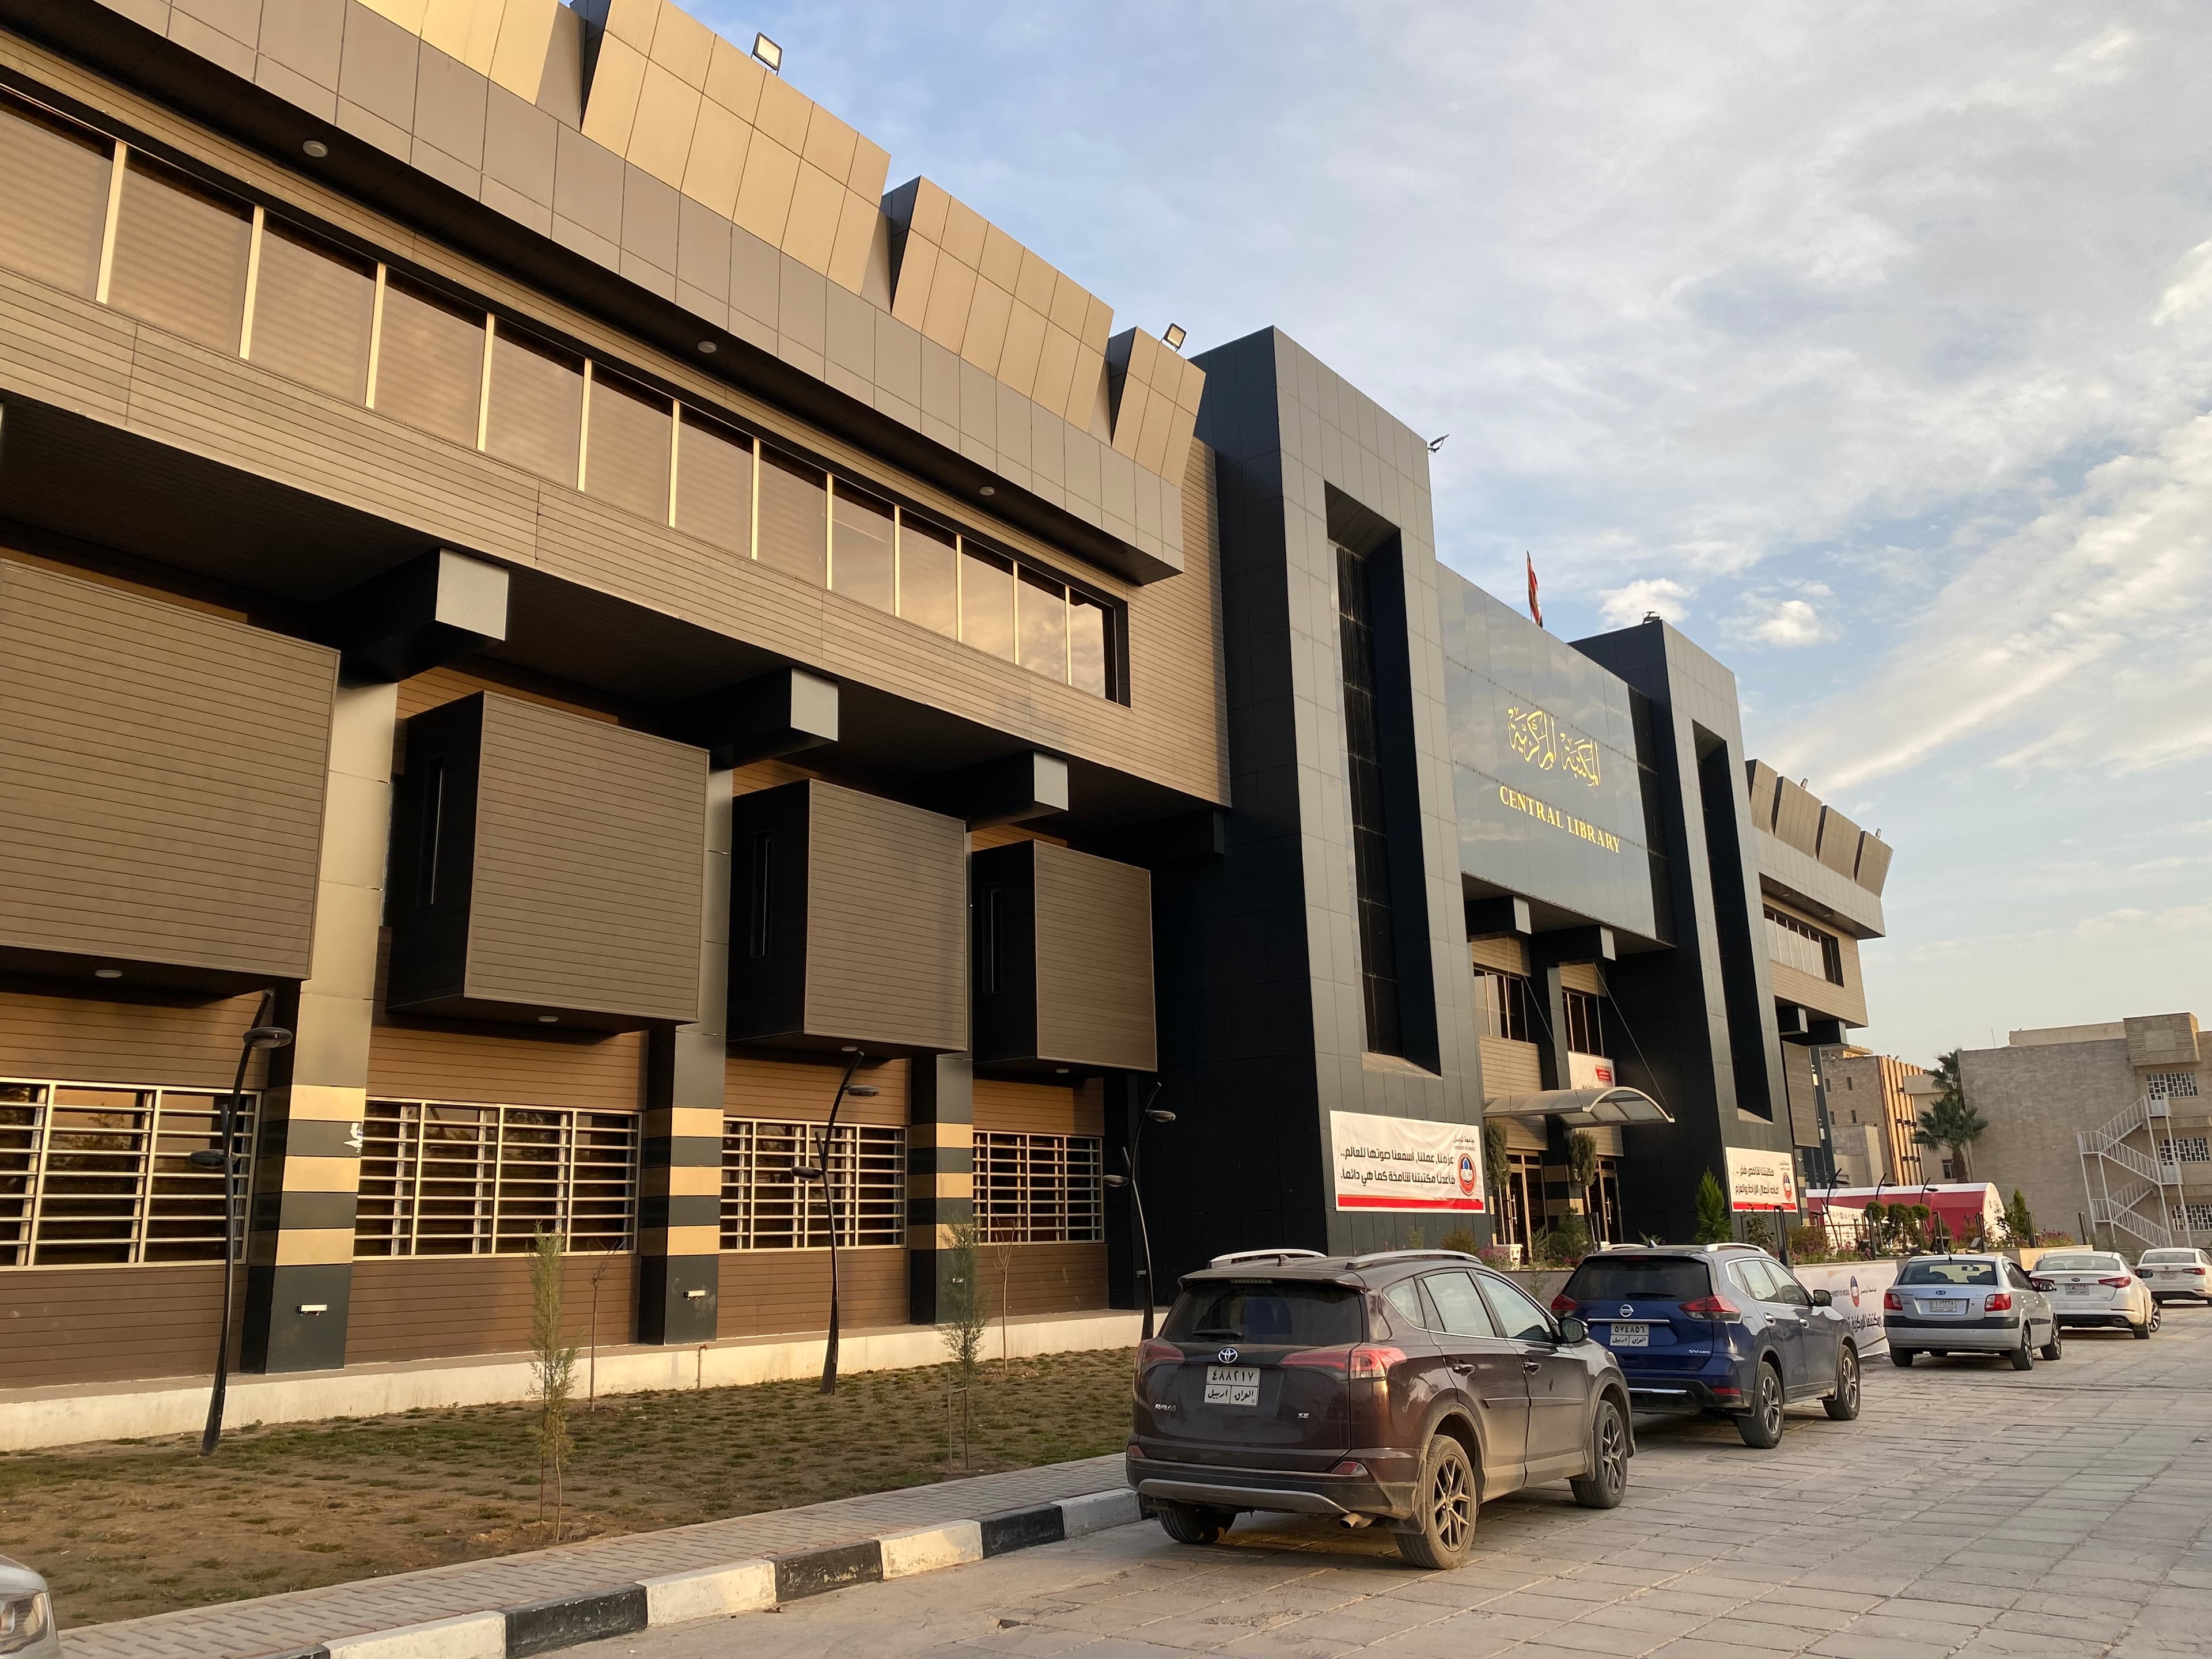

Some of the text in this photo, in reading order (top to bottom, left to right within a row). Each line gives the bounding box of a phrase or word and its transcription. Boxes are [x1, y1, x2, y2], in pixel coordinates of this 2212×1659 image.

[1499, 785, 1620, 854] CENTRAL LIBRARY
[1367, 1147, 1390, 1161] صوتها
[1392, 1148, 1414, 1161] أسمعنا
[1361, 1171, 1373, 1186] هي
[1374, 1170, 1387, 1181] كما
[1389, 1171, 1411, 1182] شامخة
[1412, 1172, 1435, 1185] مكتبتنا
[1212, 1370, 1253, 1382] ٤٨٨٢١٧
